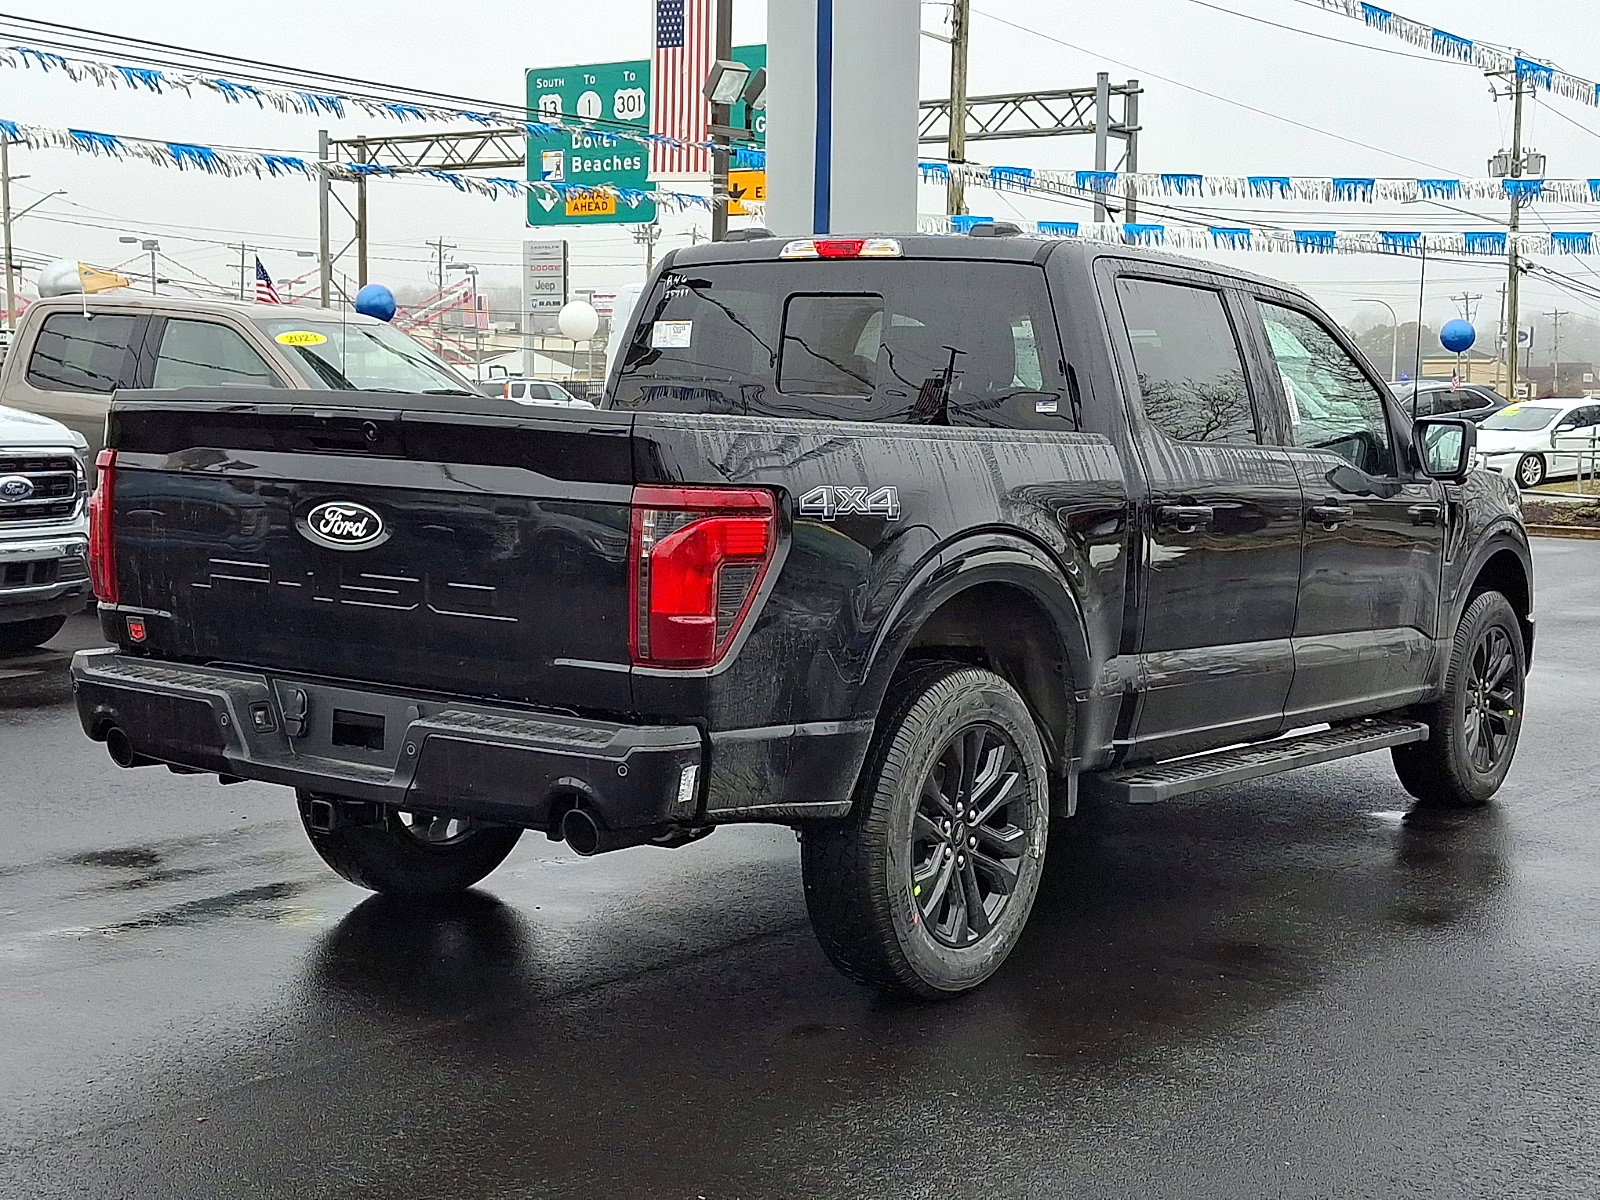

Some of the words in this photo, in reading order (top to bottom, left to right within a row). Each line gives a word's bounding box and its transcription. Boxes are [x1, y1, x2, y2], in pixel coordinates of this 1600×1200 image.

[543, 101, 558, 118] 13
[616, 94, 641, 113] 301
[571, 155, 641, 173] Beaches
[573, 201, 608, 212] AHEAD
[534, 279, 556, 292] Jeep
[286, 334, 318, 343] 2023
[5, 483, 26, 494] Ford
[319, 506, 369, 537] Ford
